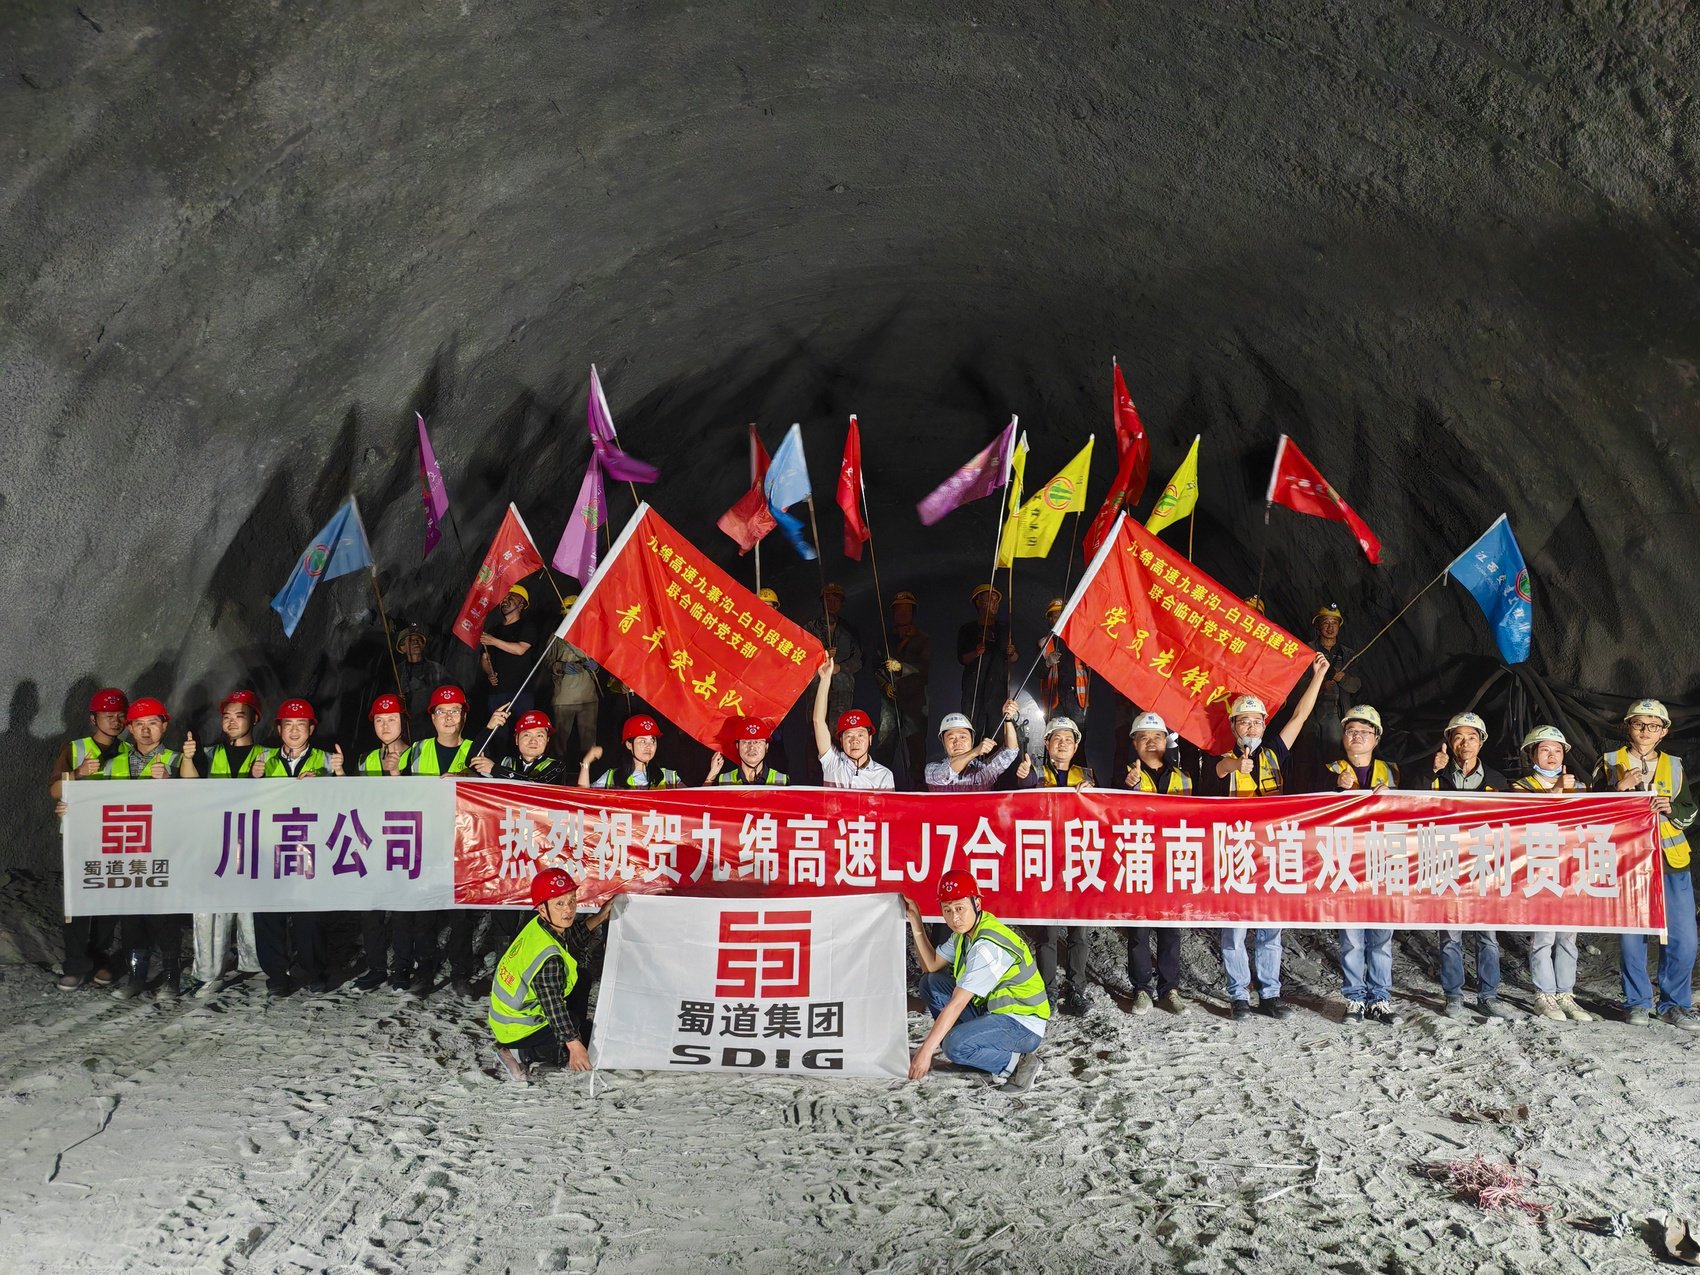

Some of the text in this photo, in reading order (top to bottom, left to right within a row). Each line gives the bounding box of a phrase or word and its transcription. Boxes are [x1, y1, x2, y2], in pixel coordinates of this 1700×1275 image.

[647, 535, 808, 666] 九绵高速九寨沟-白马段建设
[665, 581, 758, 660] 联合临时党支部
[1126, 540, 1300, 659] 九绵高速九寨沟-白马段建设
[1148, 583, 1248, 655] 联合临时党支部
[616, 603, 746, 717] 青年突击队
[1101, 606, 1233, 715] 党员先锋队
[83, 859, 170, 876] 蜀道集团
[215, 807, 424, 880] 川高公司
[499, 807, 1620, 898] 热烈祝贺九绵高速LJ7合同段蒲南隧道双幅顺利贯通
[82, 875, 170, 890] SDIG
[669, 1044, 845, 1070] SDIG
[677, 1000, 845, 1039] 蜀道集团
